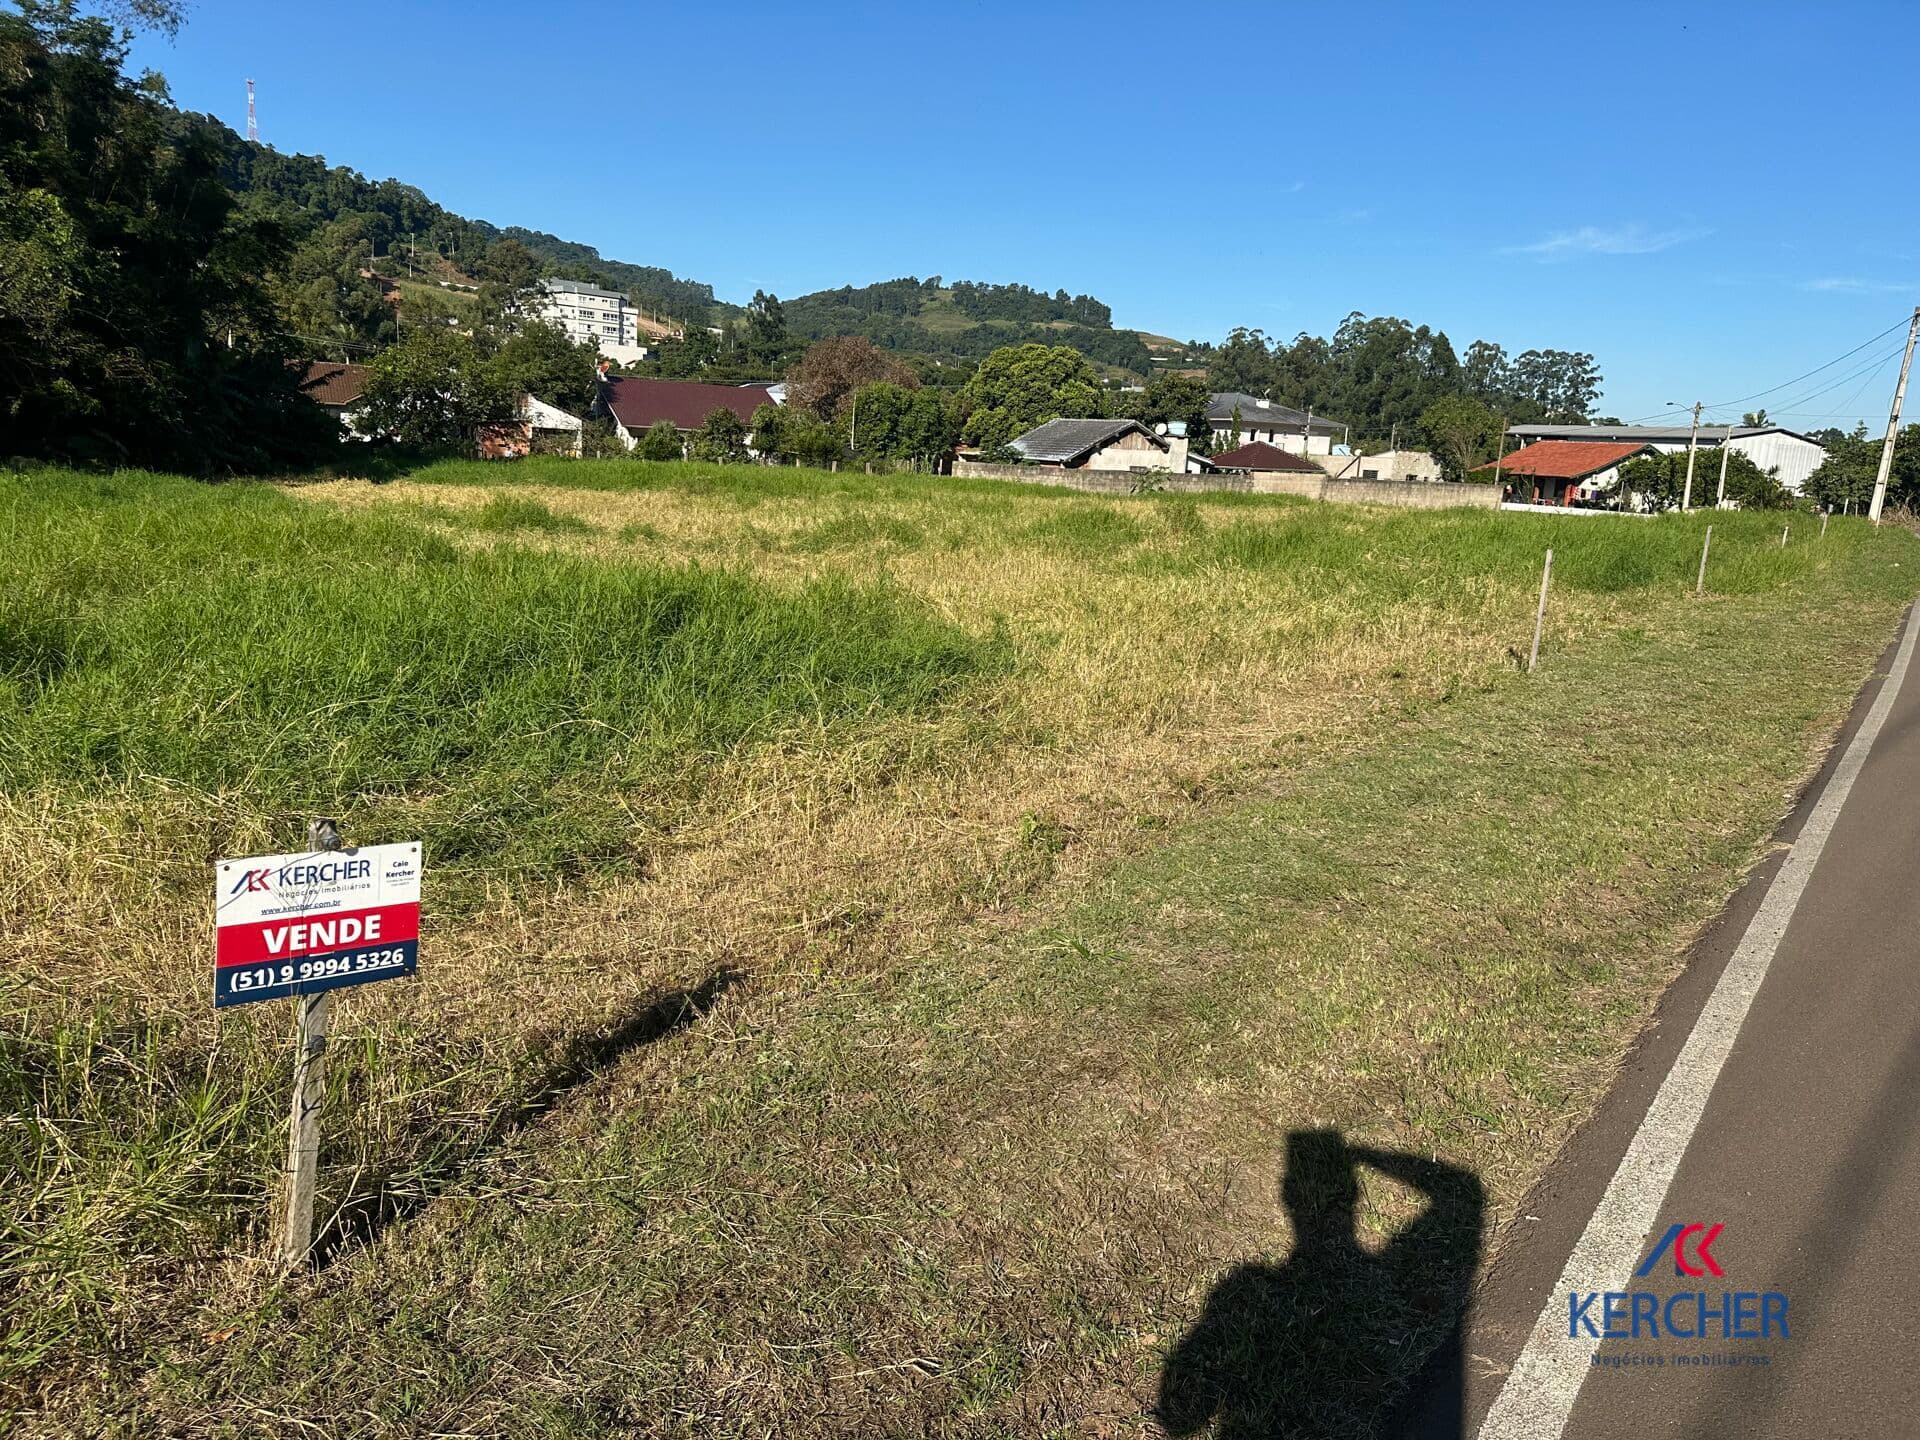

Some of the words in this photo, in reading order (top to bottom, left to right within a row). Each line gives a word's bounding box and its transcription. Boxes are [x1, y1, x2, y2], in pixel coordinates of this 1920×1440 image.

[279, 860, 370, 886] KERCHER
[386, 870, 415, 878] Kercher
[262, 914, 382, 954] VENDE
[230, 967, 275, 992] (51)
[280, 965, 295, 983] 9
[299, 957, 351, 979] 9994
[356, 948, 405, 970] 5326
